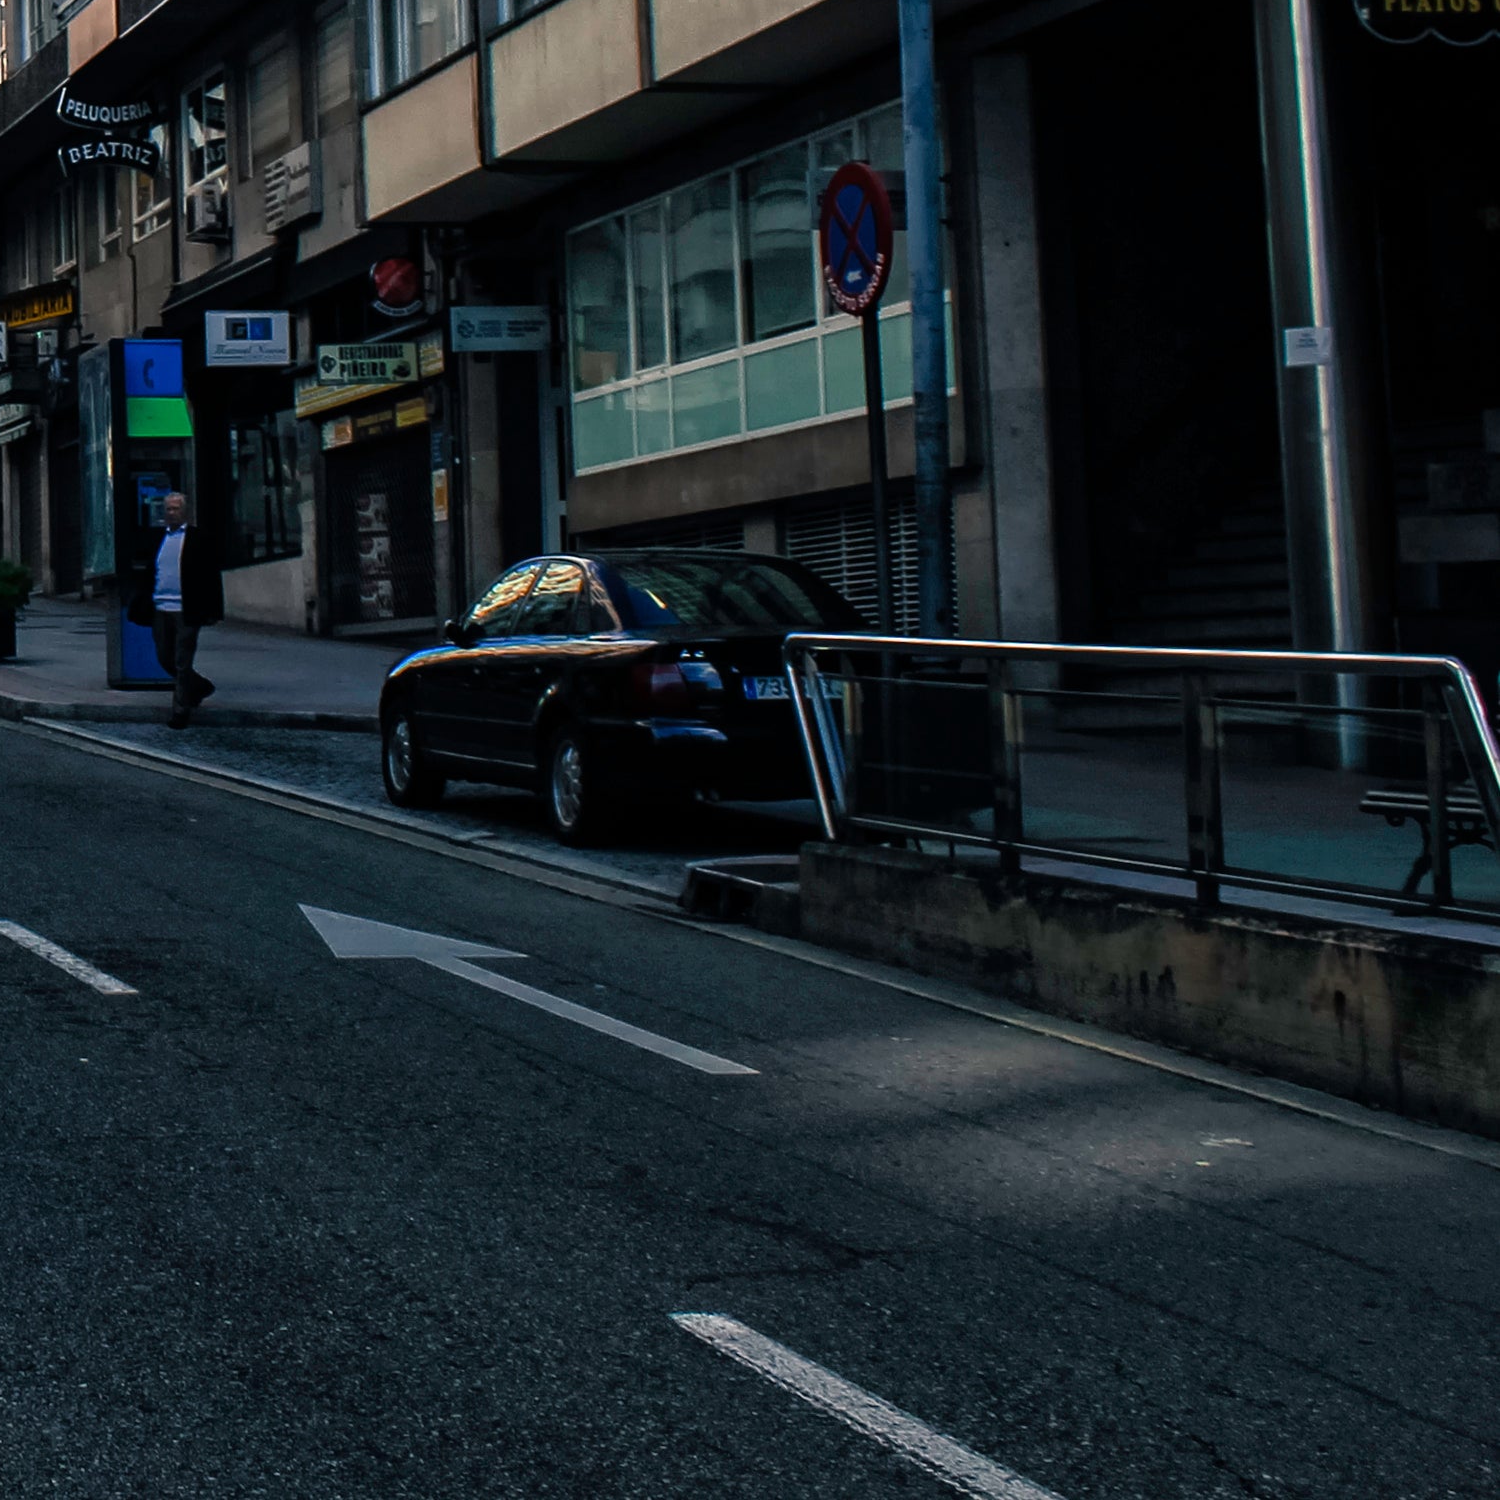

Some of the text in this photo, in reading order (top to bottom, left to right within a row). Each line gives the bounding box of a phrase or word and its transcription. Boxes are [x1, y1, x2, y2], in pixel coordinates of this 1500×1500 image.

[65, 98, 152, 124] PELUQUERIA
[68, 141, 152, 165] BEATRIZ
[338, 345, 404, 359] REGISTRADORAS
[339, 360, 386, 378] PIÑEIRO
